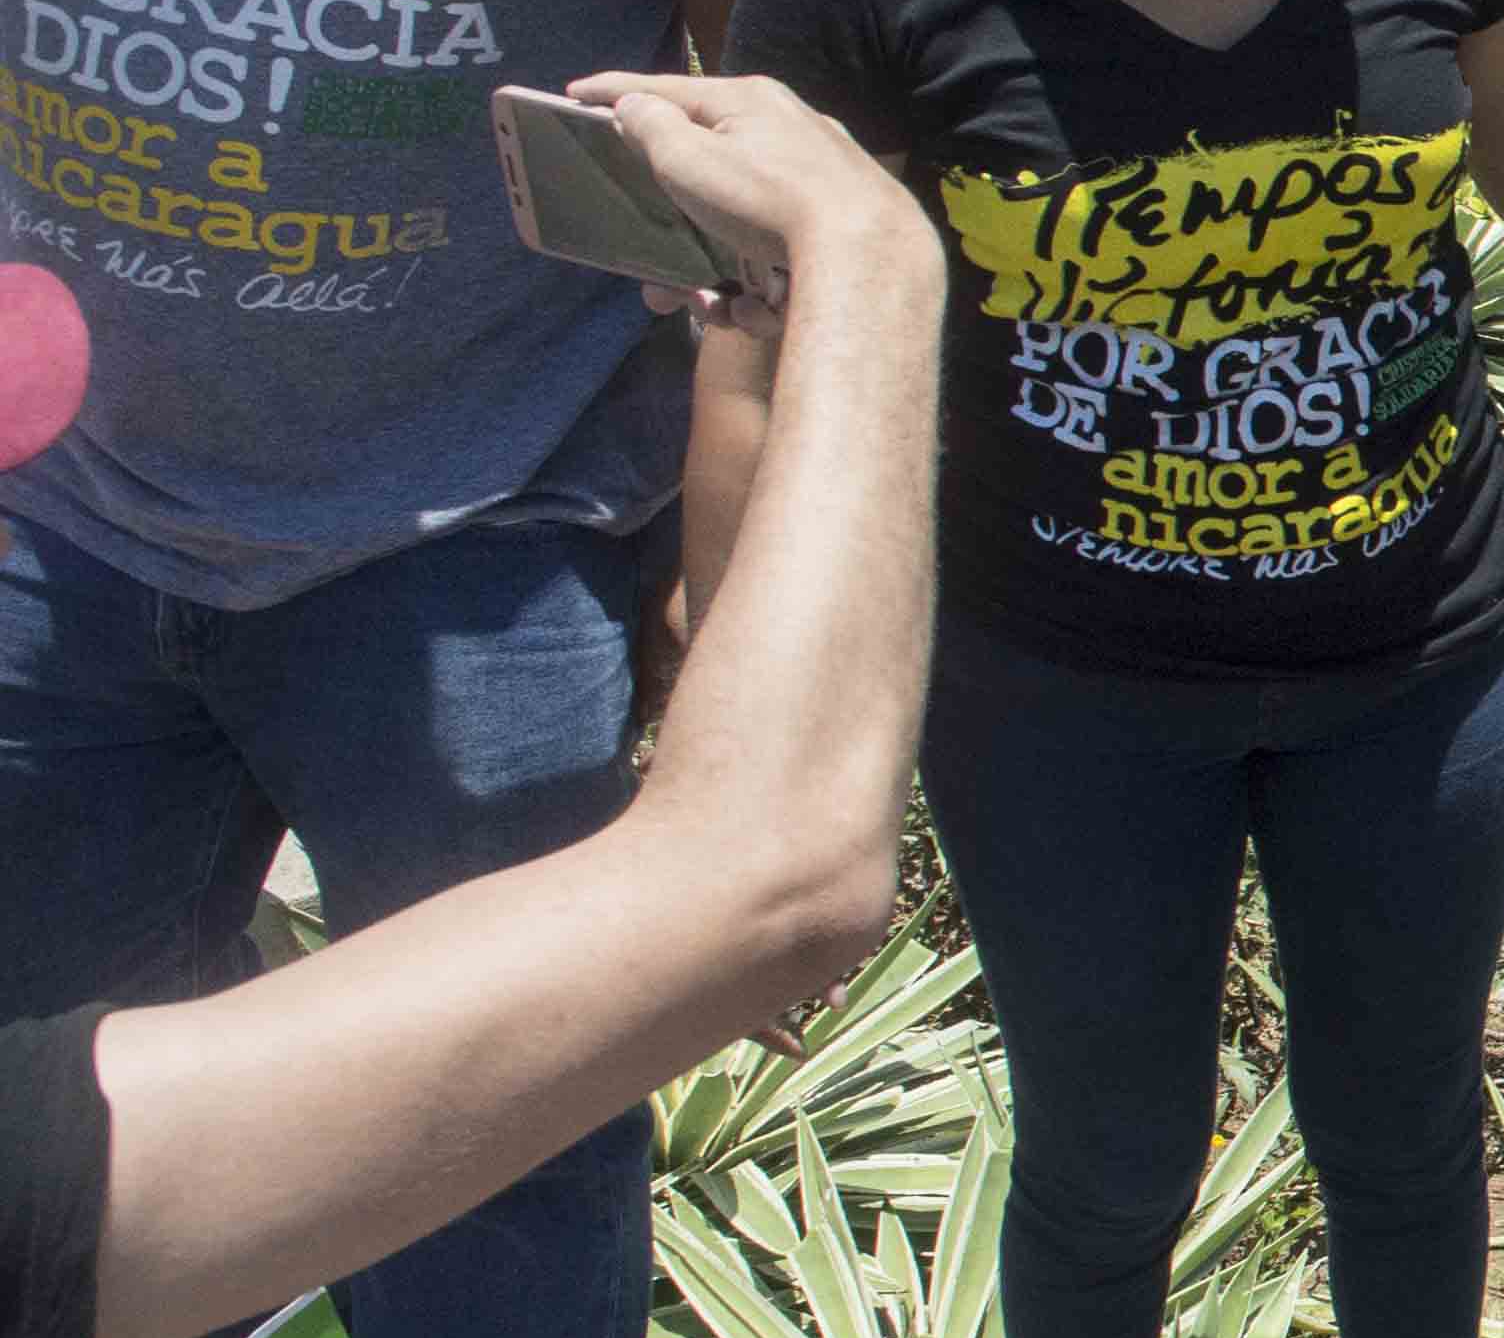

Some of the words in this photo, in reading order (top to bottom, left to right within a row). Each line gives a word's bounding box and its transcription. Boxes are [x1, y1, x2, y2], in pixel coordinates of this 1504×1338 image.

[207, 139, 270, 194] a
[1008, 316, 1182, 403] POR
[1150, 372, 1374, 461] DIOS!
[1102, 447, 1305, 510] amor
[1322, 441, 1370, 491] a
